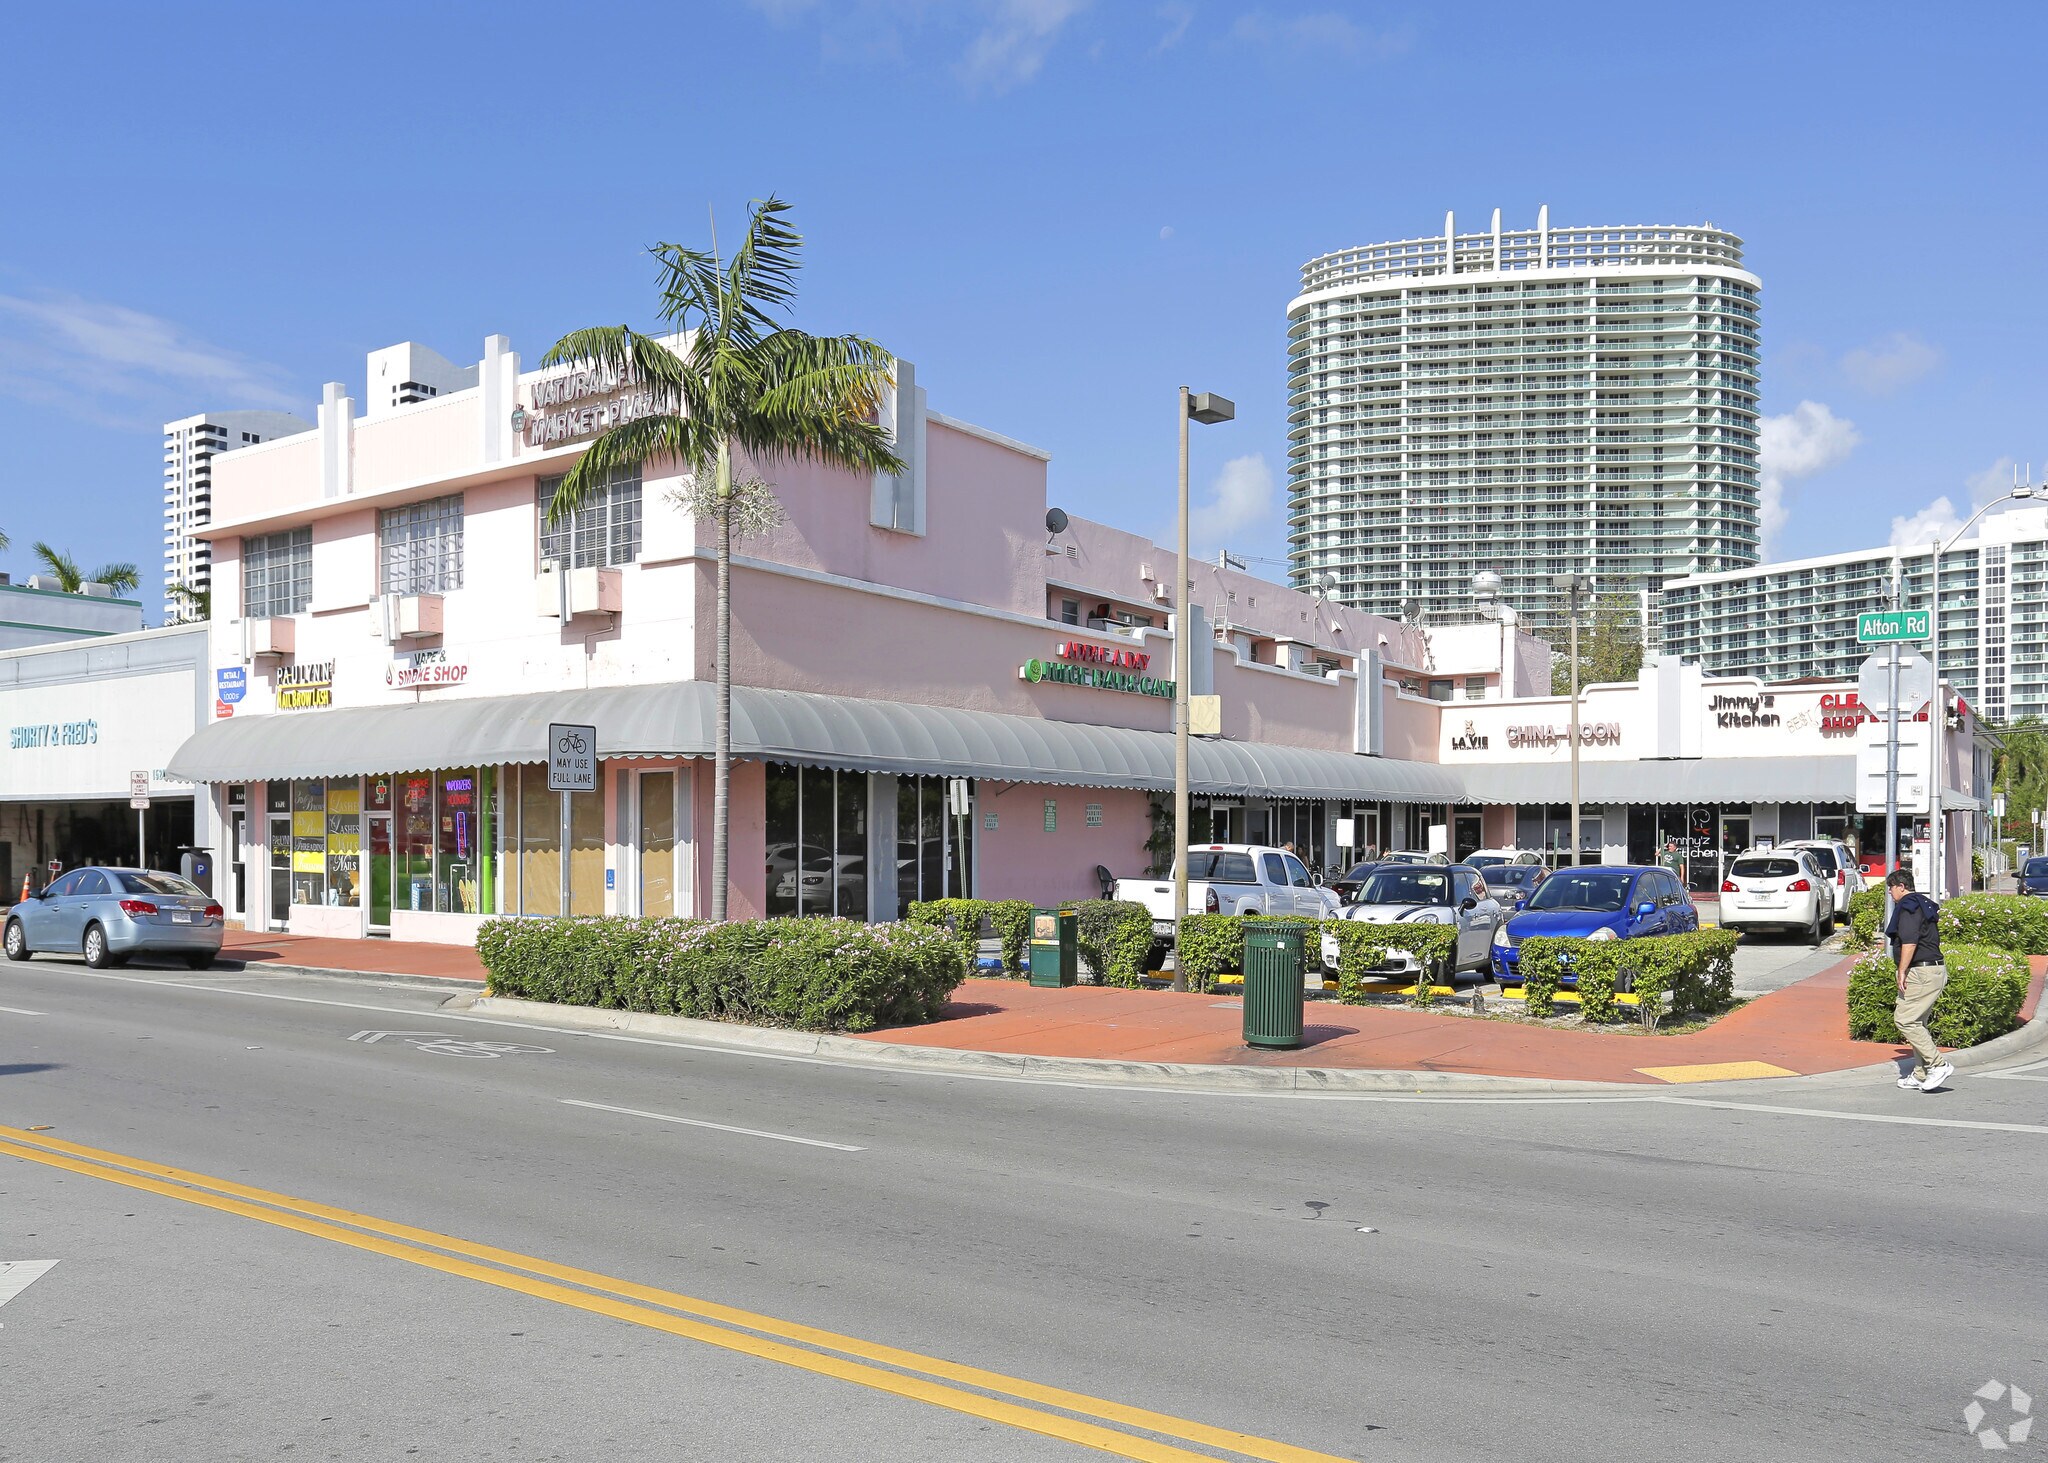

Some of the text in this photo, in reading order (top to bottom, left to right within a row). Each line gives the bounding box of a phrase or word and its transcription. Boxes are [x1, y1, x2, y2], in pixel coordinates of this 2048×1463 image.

[532, 403, 604, 446] MARKET
[1863, 616, 1926, 636] Alton Rd
[414, 650, 446, 665] VAPE &
[1064, 641, 1151, 671] APPLE A DAY
[398, 665, 468, 686] SMOKE SHOP
[1041, 661, 1090, 687] JUICE
[1092, 668, 1126, 692] BAR
[1127, 674, 1141, 693] &
[292, 689, 313, 708] BROW
[1709, 694, 1775, 711] Jimmy'z
[1717, 712, 1780, 729] Kitchen
[10, 718, 98, 749] SHORTY & FRED'S
[1452, 736, 1489, 747] LA VIE
[1506, 725, 1556, 741] CHINA
[556, 758, 589, 769] MAY USE
[552, 773, 592, 784] FULL LANE
[1664, 834, 1711, 848] Jimmy'z
[197, 864, 205, 874] P
